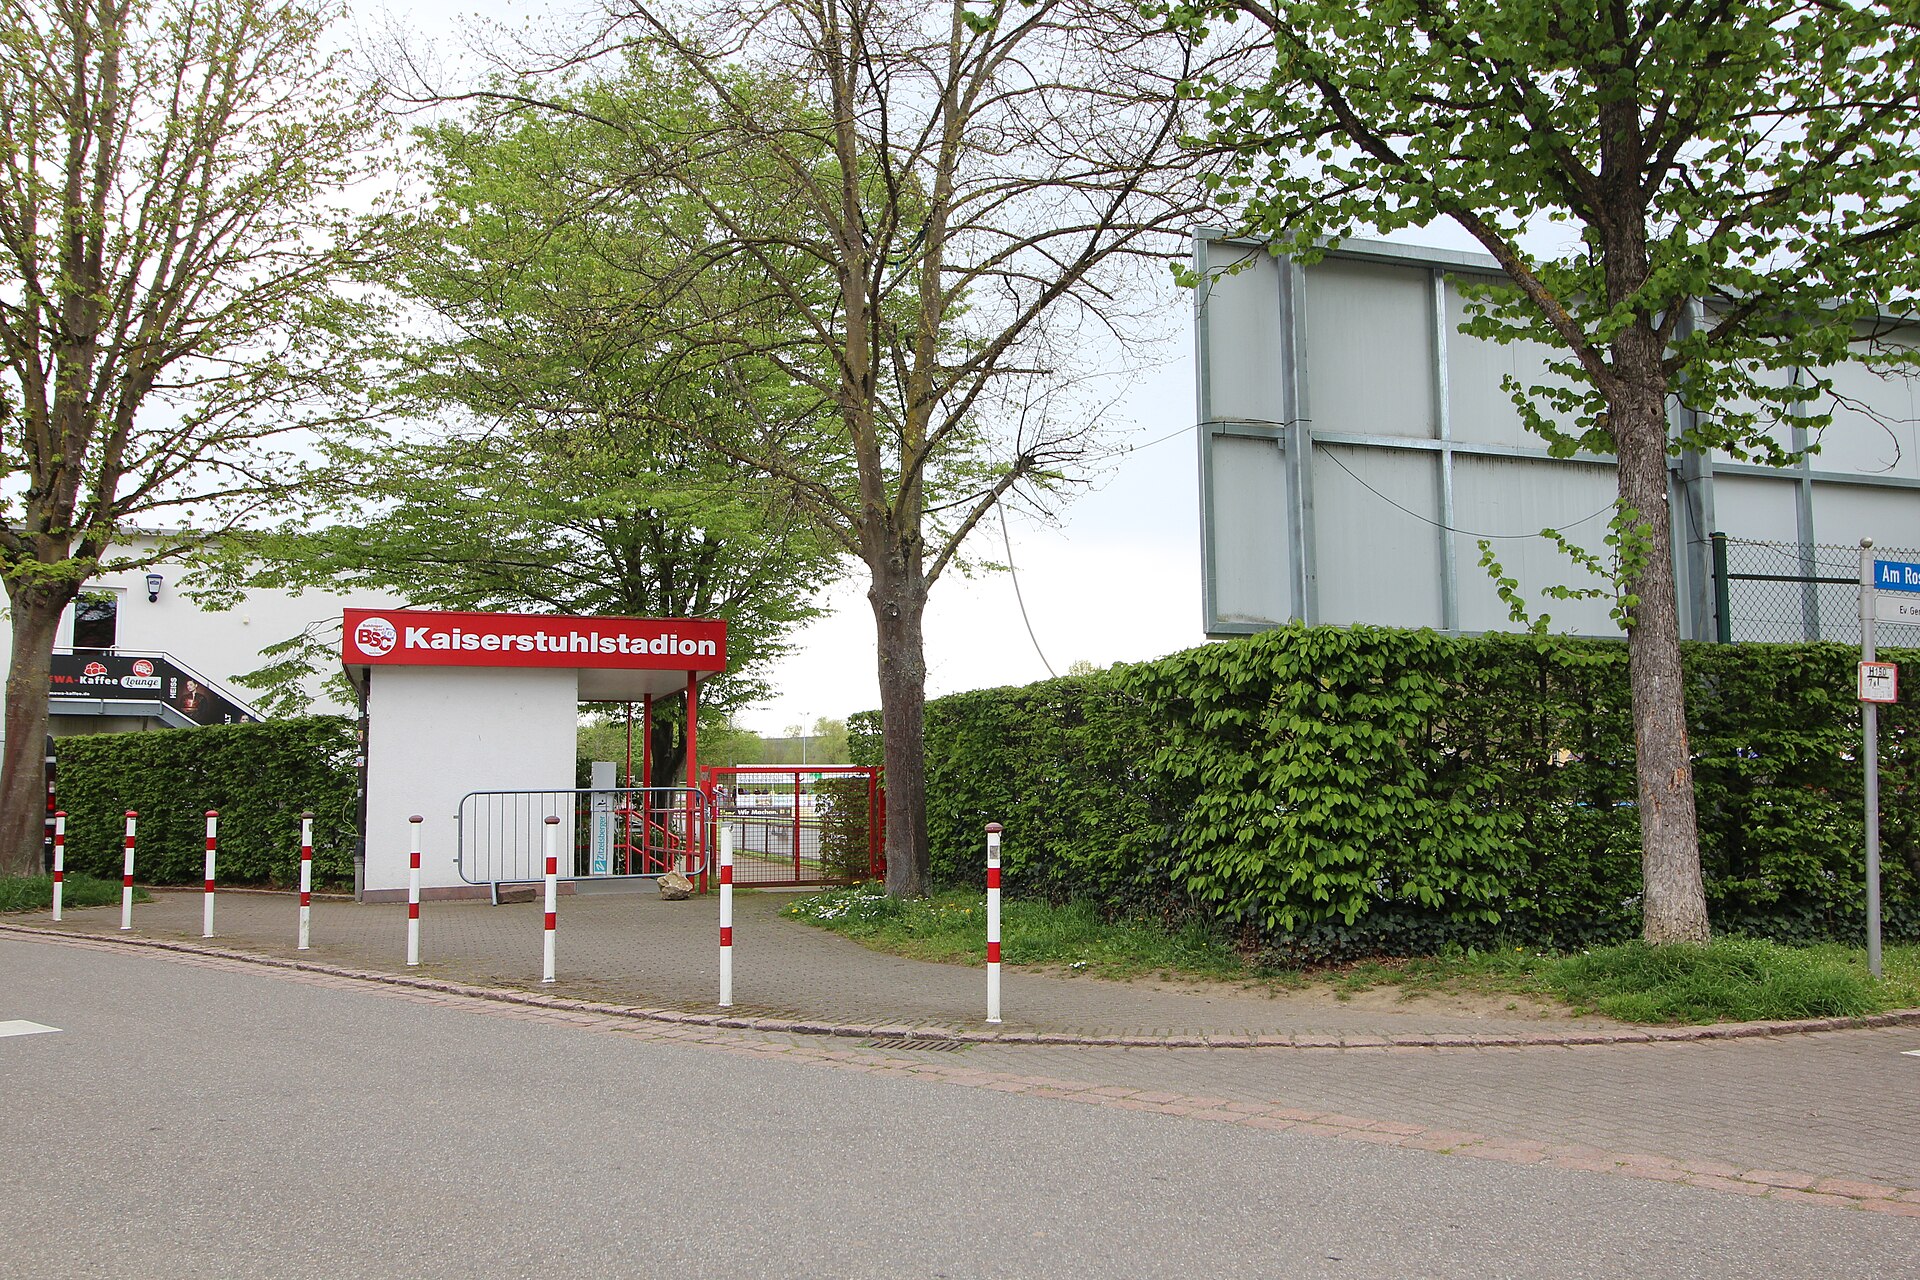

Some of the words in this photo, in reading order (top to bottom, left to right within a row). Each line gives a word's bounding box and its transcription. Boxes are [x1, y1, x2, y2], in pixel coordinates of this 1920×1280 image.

[1882, 565, 1900, 583] Am
[358, 629, 392, 651] BSC
[405, 627, 716, 656] Kaiserstuhlstadion
[48, 676, 118, 685] EWA-Kaffee
[125, 677, 159, 687] Lounge
[170, 677, 178, 699] HEISS
[597, 816, 607, 860] Zitzelsberger
